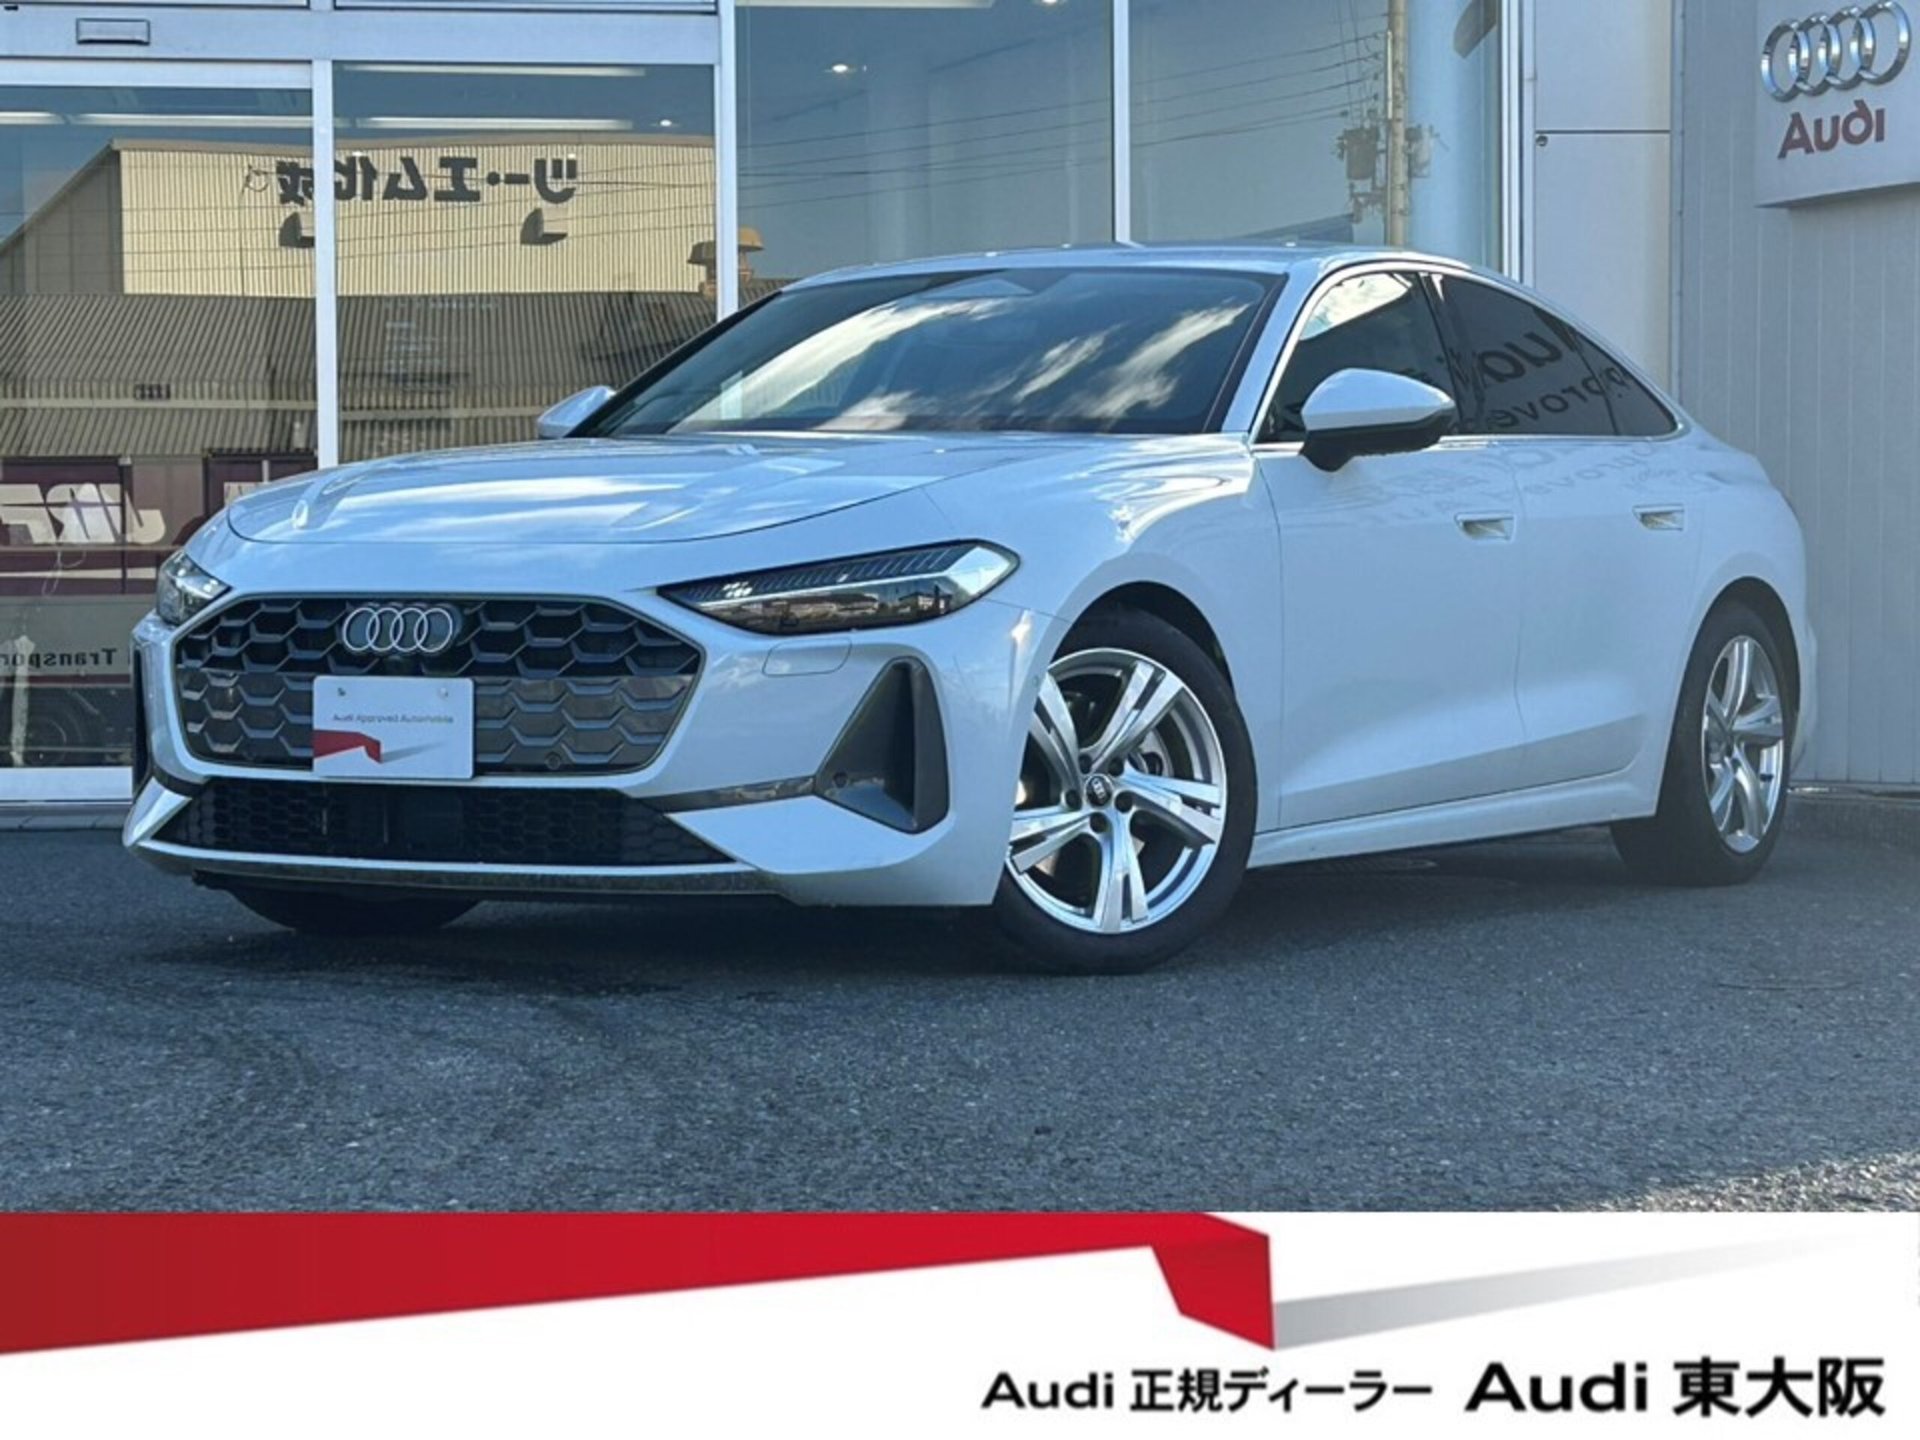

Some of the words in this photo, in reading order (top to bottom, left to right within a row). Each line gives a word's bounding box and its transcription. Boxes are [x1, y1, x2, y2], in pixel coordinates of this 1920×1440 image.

[1776, 99, 1886, 160] Audi
[333, 713, 354, 722] Audi
[357, 714, 399, 724] Approved
